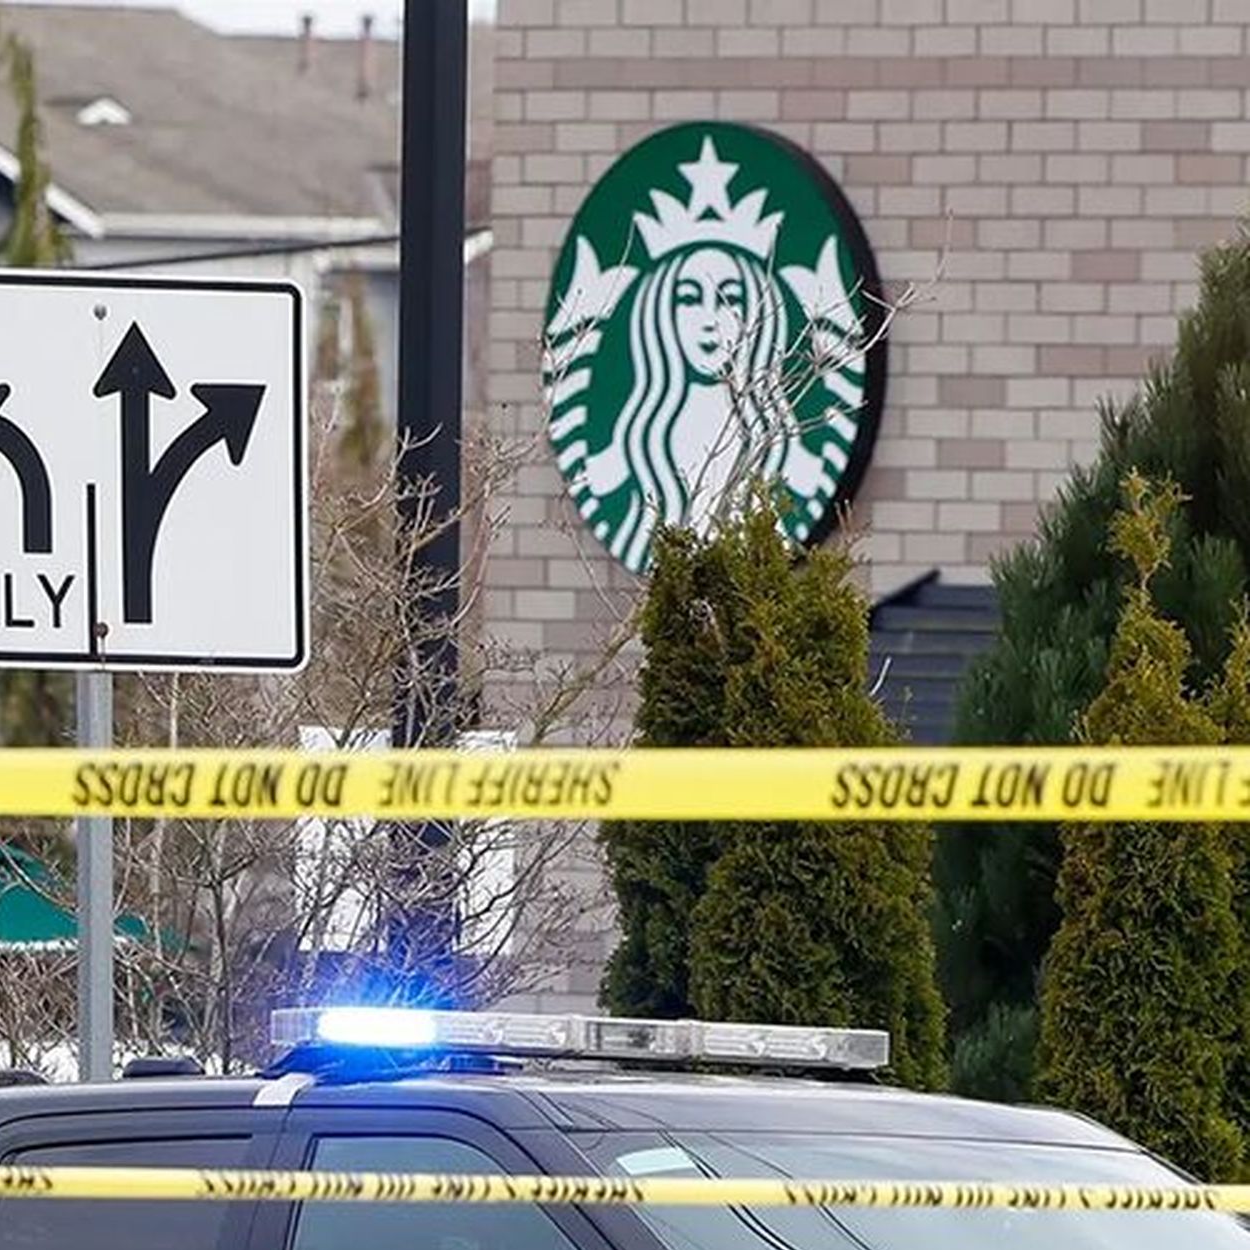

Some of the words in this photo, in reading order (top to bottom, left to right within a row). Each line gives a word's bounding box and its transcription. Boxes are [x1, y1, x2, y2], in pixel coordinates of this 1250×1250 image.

[72, 763, 195, 807] CROSS
[209, 762, 285, 807] NOT
[296, 763, 350, 807] DO
[377, 762, 457, 807] LINE
[467, 761, 622, 807] SHERIFF
[831, 761, 961, 808] CROSS
[970, 761, 1051, 808] NOT
[1061, 761, 1117, 808] DO
[1146, 761, 1231, 808] LINE
